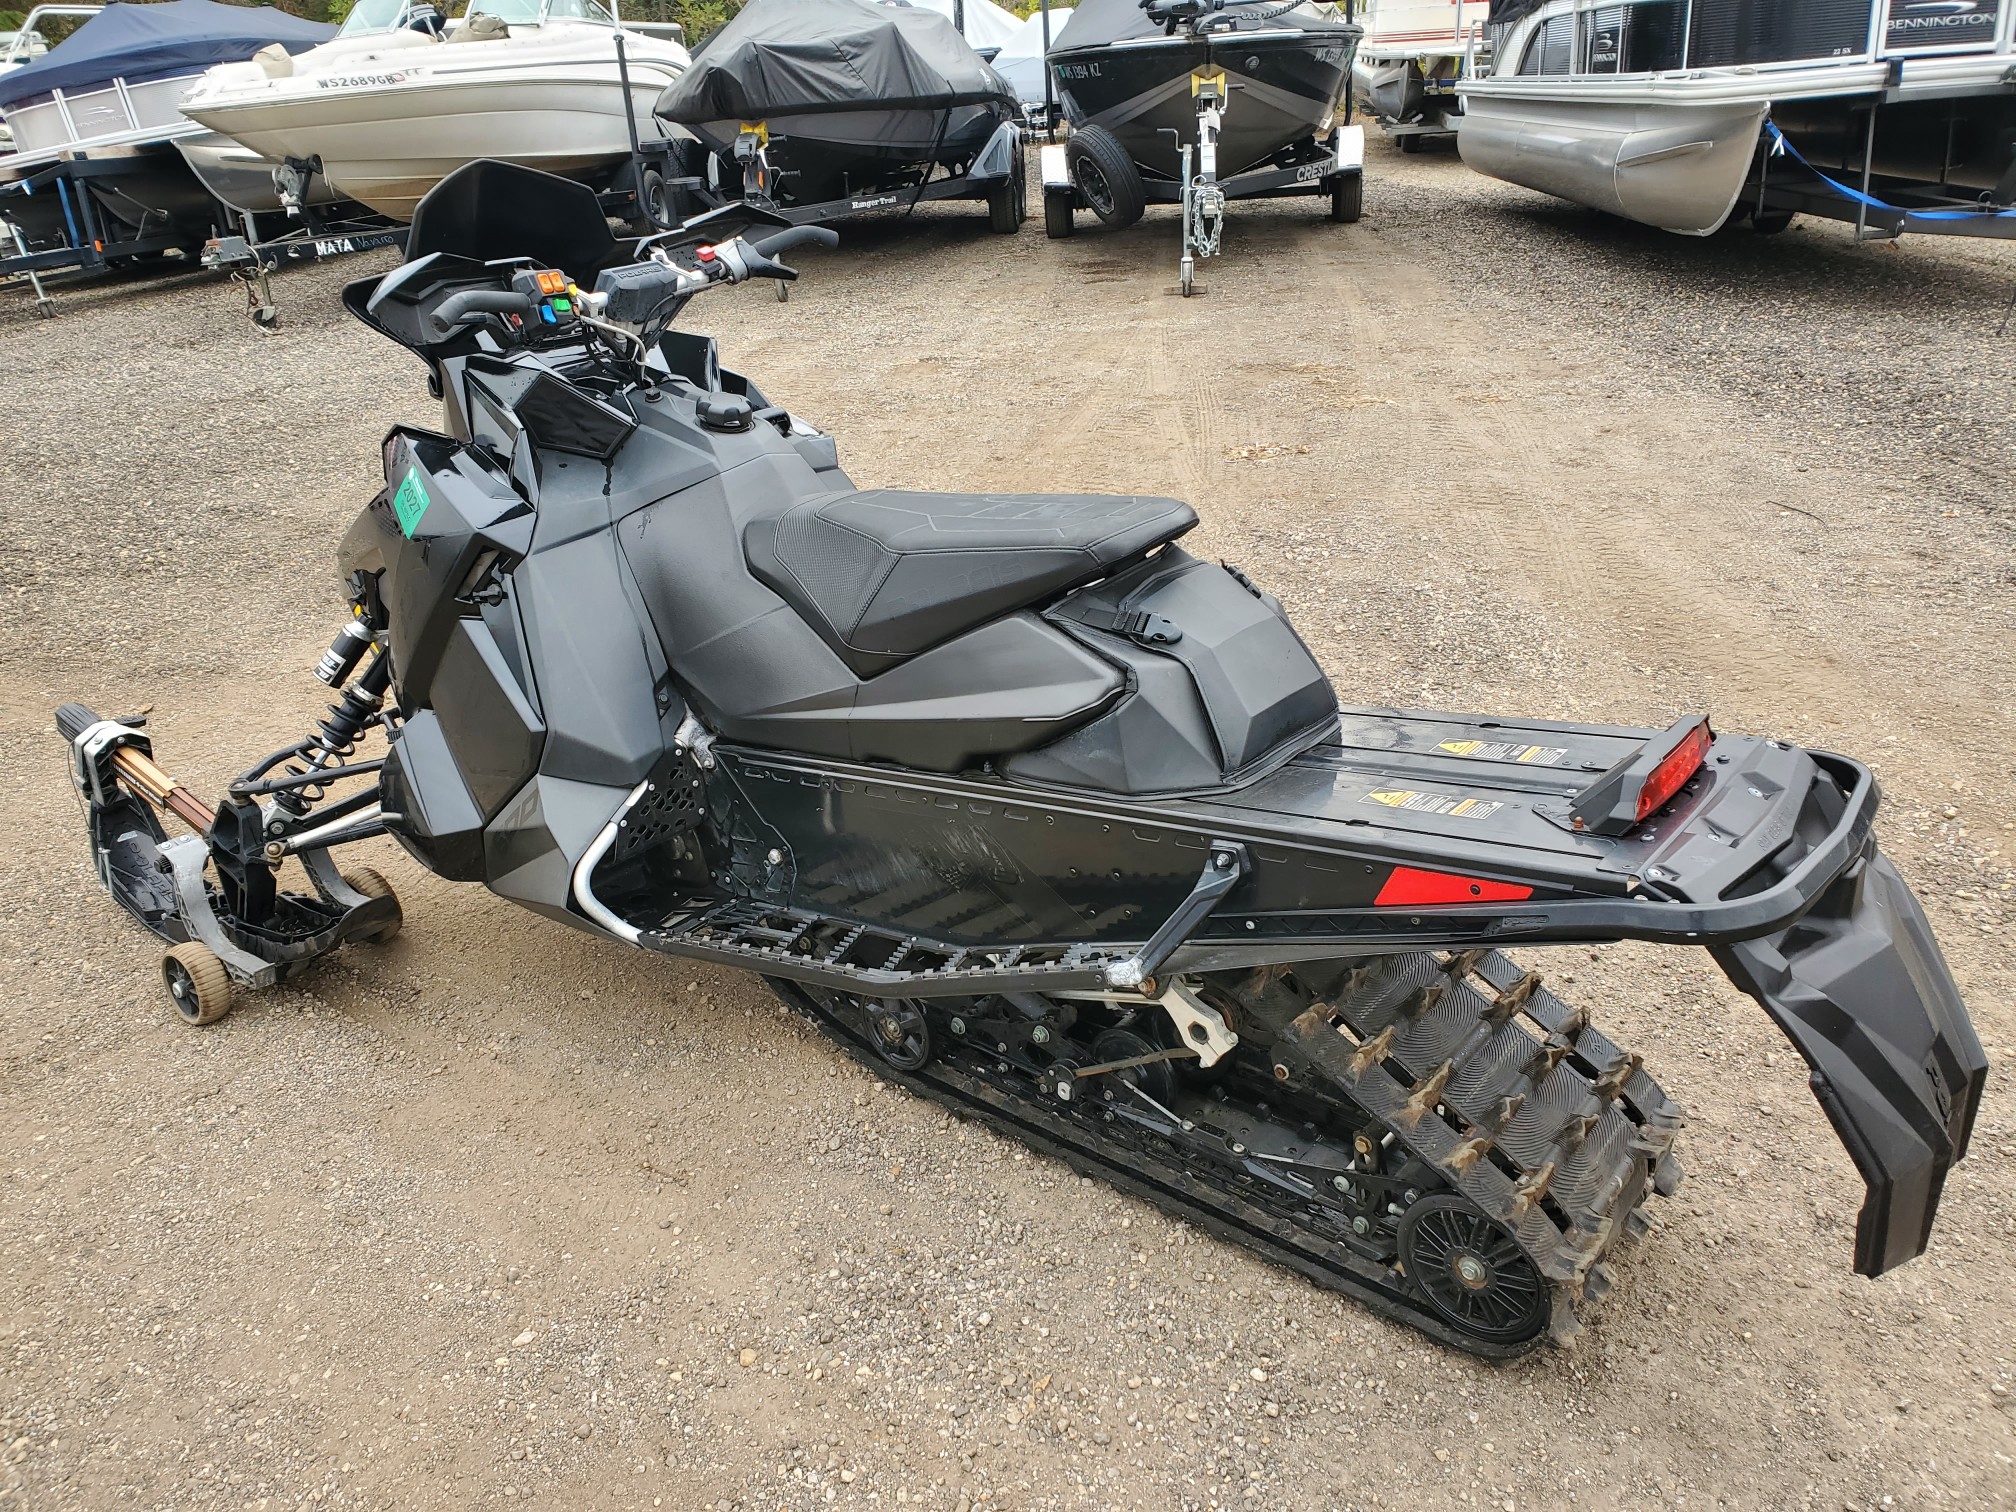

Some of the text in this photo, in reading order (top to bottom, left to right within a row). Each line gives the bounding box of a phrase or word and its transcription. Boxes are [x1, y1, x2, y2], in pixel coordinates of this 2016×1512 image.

[1886, 12, 1997, 30] BENNINGTON
[852, 195, 897, 209] Ranger Trail
[315, 238, 355, 256] MATA
[617, 265, 662, 280] POLARIS
[403, 481, 421, 516] 2027
